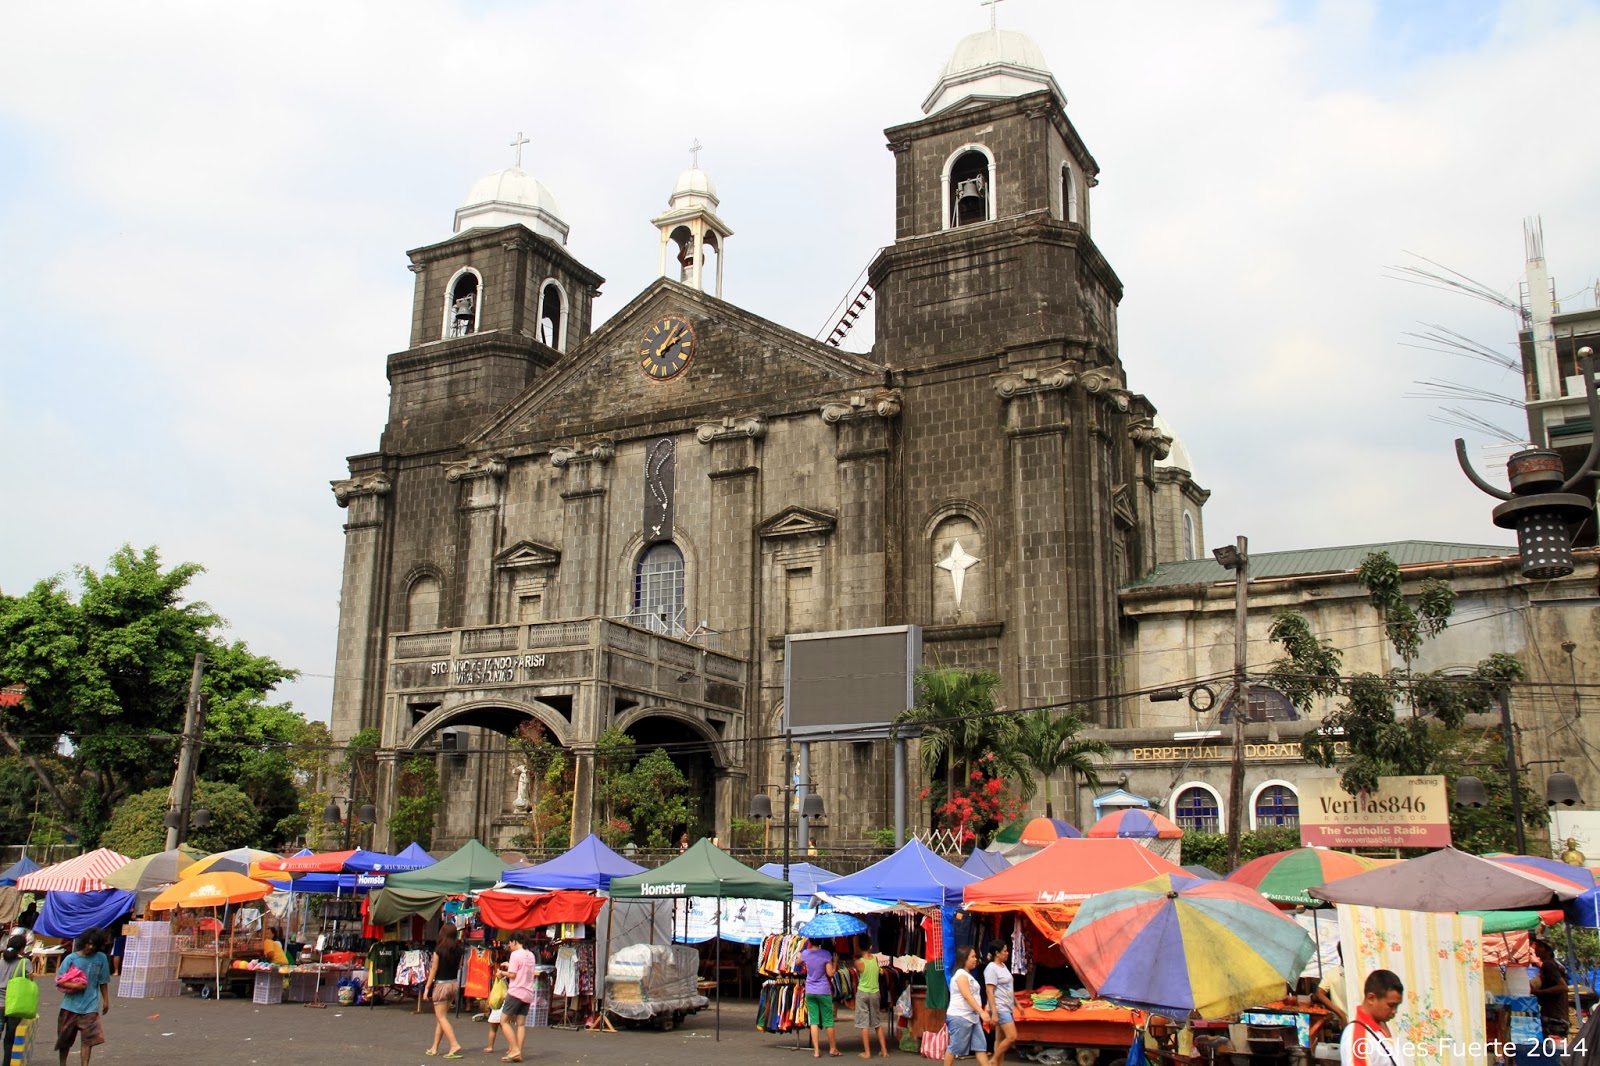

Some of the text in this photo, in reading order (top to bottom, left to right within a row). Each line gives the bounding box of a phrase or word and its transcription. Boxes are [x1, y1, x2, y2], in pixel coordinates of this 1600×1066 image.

[431, 662, 449, 674] STO.
[514, 654, 545, 668] PARISH
[1133, 745, 1224, 760] PERPETUAL
[1319, 826, 1427, 835] The Catholic Radio
[358, 874, 385, 885] Homsta
[640, 882, 687, 896] Homstar
